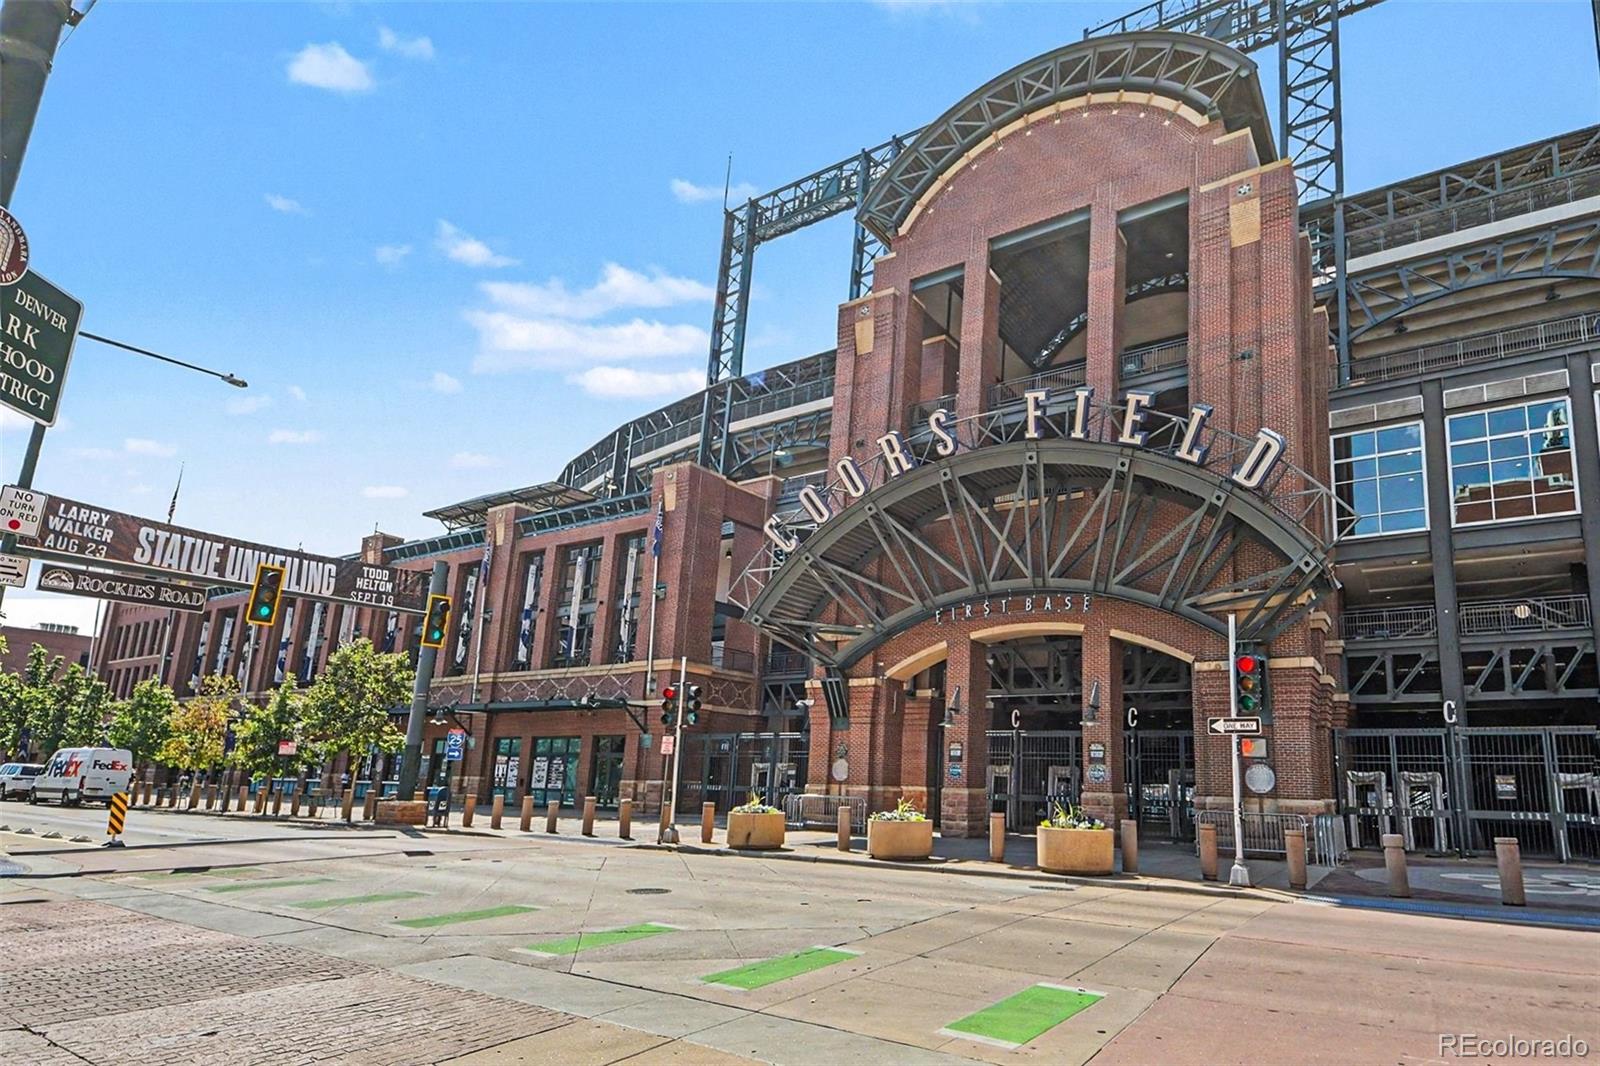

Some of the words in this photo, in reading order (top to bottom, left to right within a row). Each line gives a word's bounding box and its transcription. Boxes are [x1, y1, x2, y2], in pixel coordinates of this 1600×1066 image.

[14, 288, 68, 333] DENVER
[0, 313, 40, 350] RK
[0, 372, 50, 410] TRICT
[763, 408, 958, 553] COORS
[1024, 387, 1288, 489] FIELD
[9, 500, 35, 512] TURN
[14, 490, 34, 502] NO
[0, 508, 14, 517] ON
[18, 512, 38, 523] RED
[58, 503, 111, 527] LARRY
[48, 515, 114, 543] WALKER
[44, 534, 79, 552] AUG
[85, 542, 107, 559] 23
[133, 526, 224, 578] STATUE
[356, 577, 393, 592] HELTON
[362, 566, 389, 581] TODD
[76, 574, 156, 599] ROCKIES
[159, 586, 205, 606] ROAD
[350, 591, 378, 604] SEPT
[935, 599, 1008, 624] FIRST
[1025, 596, 1091, 613] BASE
[1011, 708, 1021, 728] C
[1127, 707, 1138, 727] C
[1443, 700, 1456, 723] C
[450, 734, 462, 745] 25
[93, 759, 128, 771] FedEx
